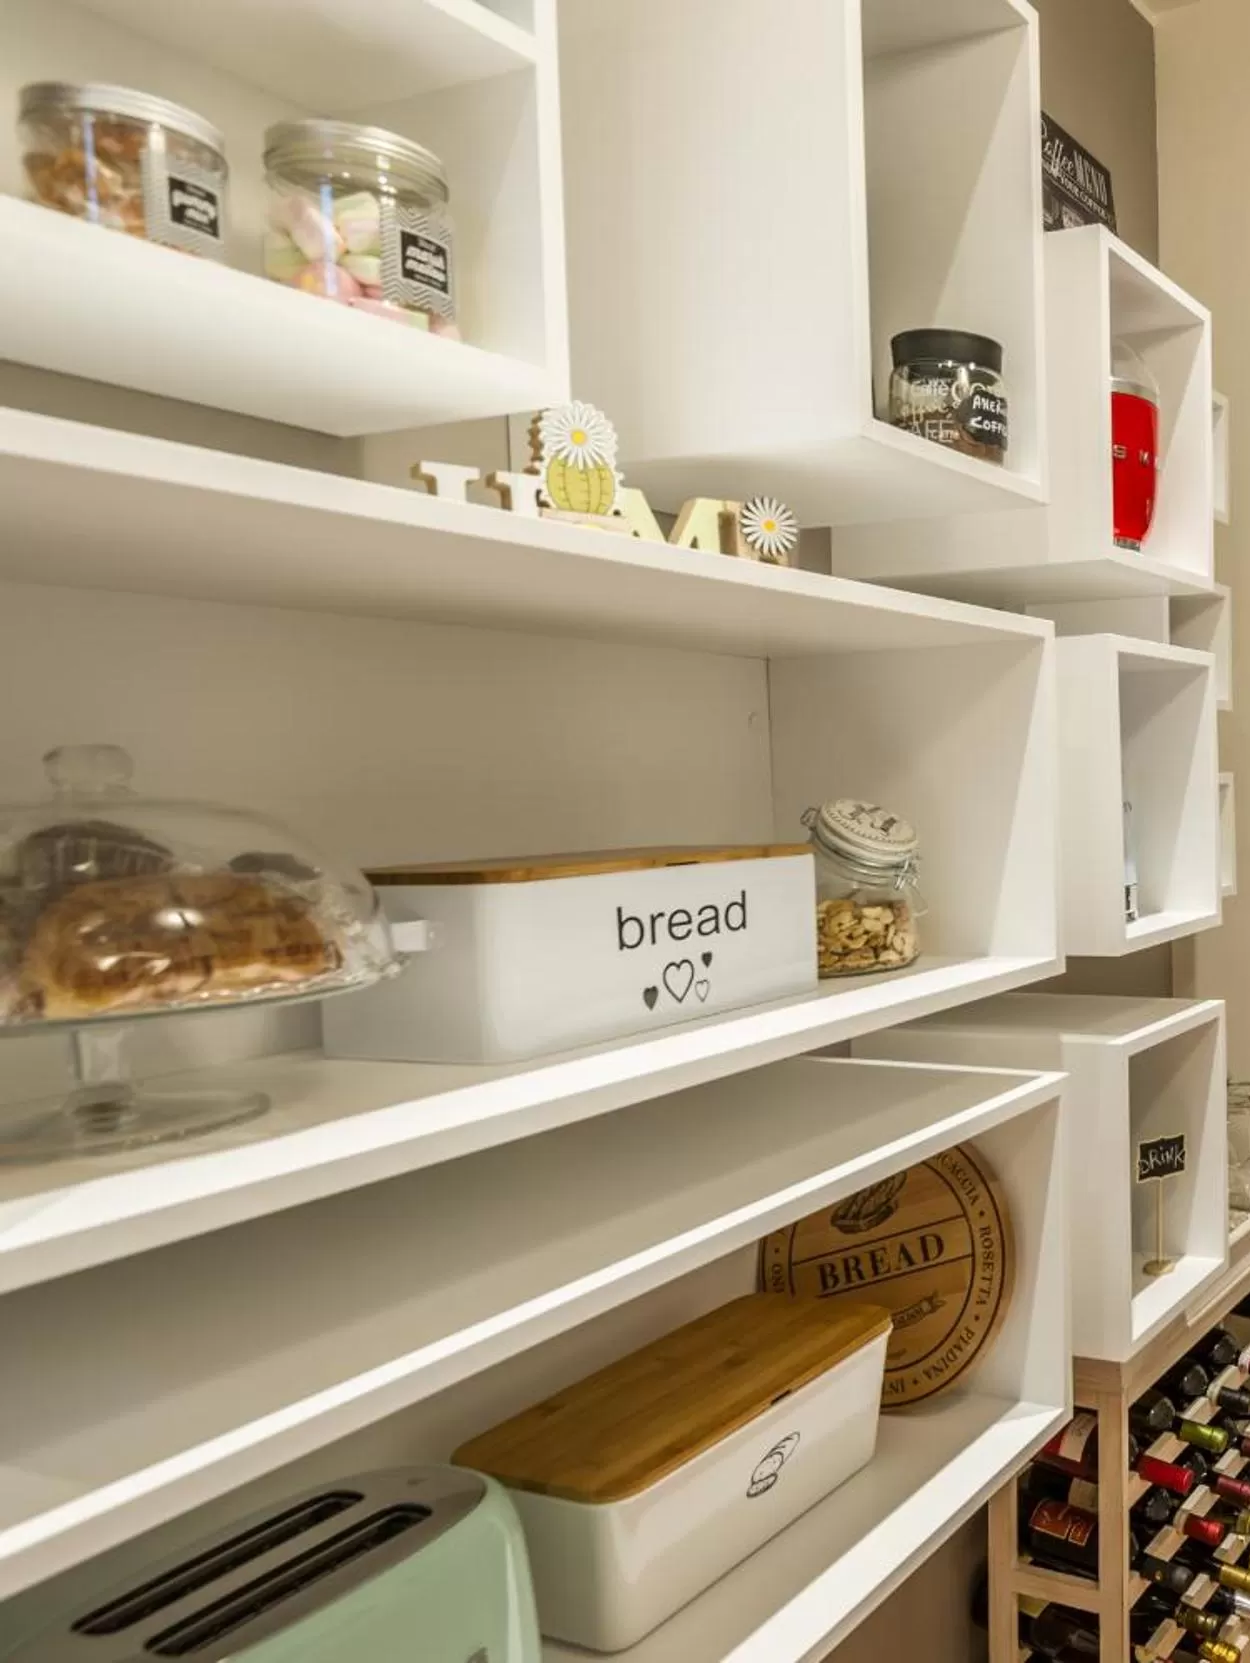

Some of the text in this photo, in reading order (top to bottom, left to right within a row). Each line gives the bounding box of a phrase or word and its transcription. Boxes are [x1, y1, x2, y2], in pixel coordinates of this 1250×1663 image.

[616, 889, 747, 951] bread
[817, 1232, 945, 1292] BREAD
[976, 1224, 996, 1306] ROSETTA
[922, 1325, 976, 1380] PIADINA
